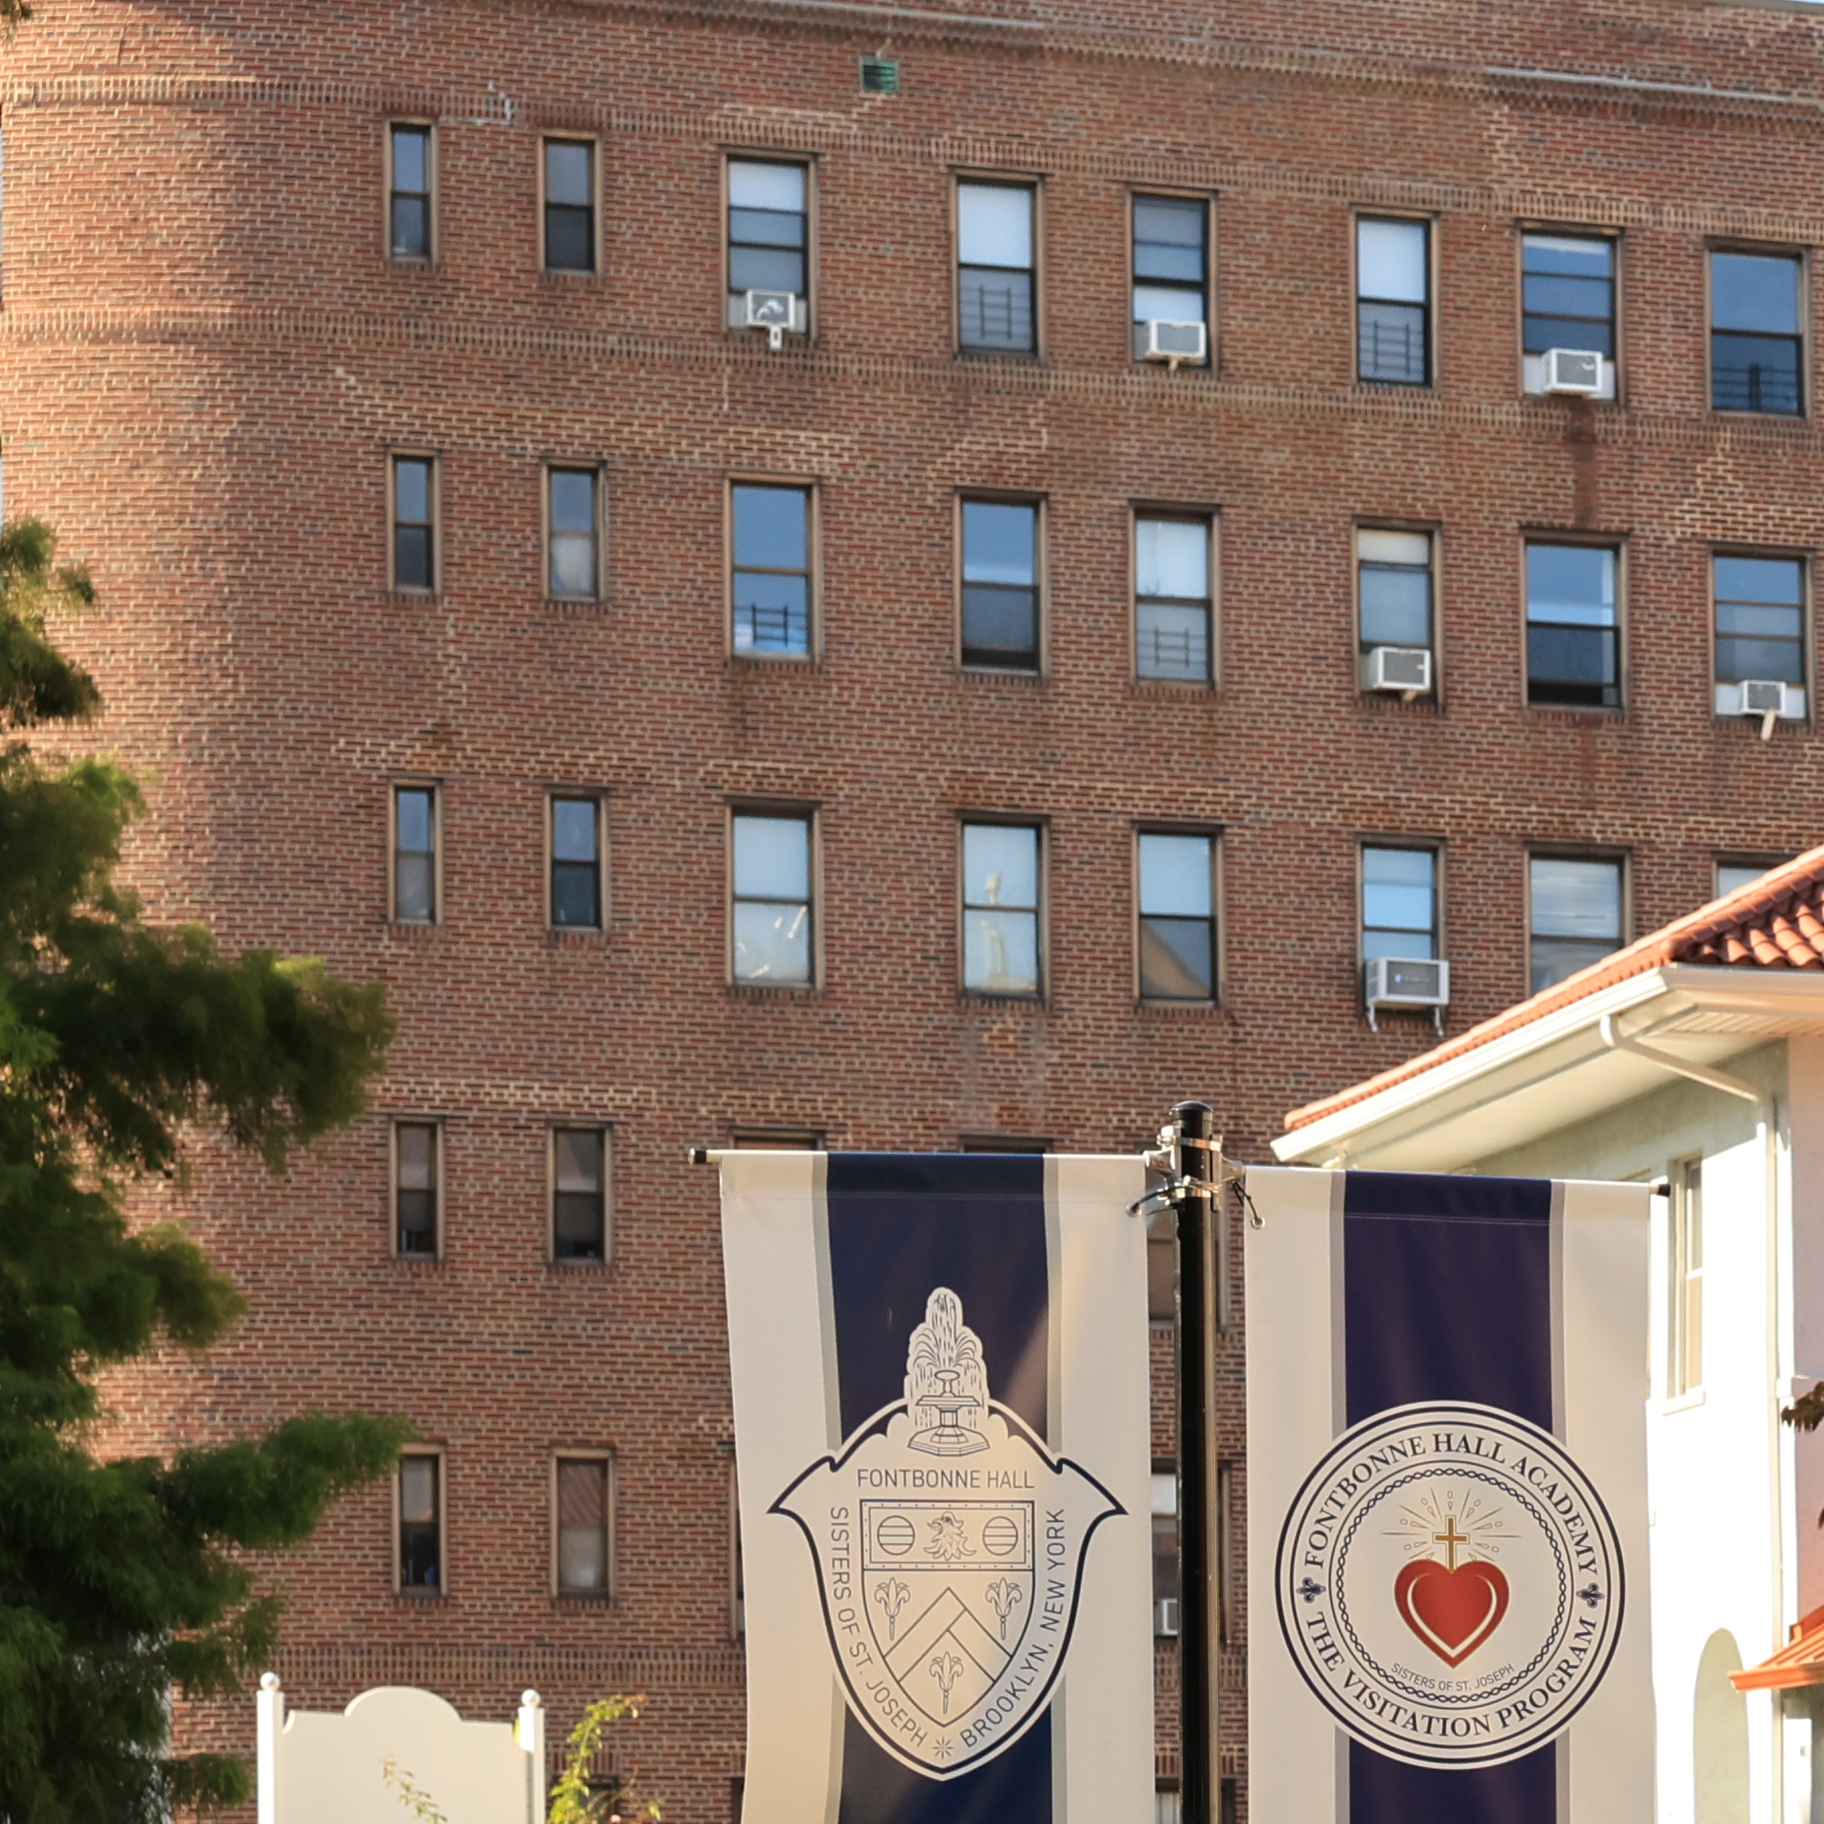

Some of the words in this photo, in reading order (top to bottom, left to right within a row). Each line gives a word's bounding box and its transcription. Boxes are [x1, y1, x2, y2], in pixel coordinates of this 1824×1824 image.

[858, 1469, 980, 1488] FONTBONNE
[987, 1470, 1035, 1489] HALL
[1305, 1436, 1426, 1569] FONTBONNE
[1433, 1433, 1506, 1463] HALL
[1511, 1456, 1598, 1576] ACADEMY
[831, 1506, 851, 1601] SISTERS
[1047, 1508, 1064, 1573] YORK
[838, 1608, 862, 1636] OF
[1040, 1579, 1065, 1632] NEW
[849, 1641, 873, 1676] ST.
[1306, 1611, 1345, 1672] THE
[1341, 1667, 1491, 1737] VISITATION
[1495, 1617, 1597, 1729] PROGRAM
[1390, 1662, 1435, 1690] SISTERS
[1438, 1681, 1452, 1691] OF
[1455, 1681, 1472, 1691] ST.
[1475, 1663, 1515, 1689] JOSEPH
[866, 1680, 928, 1747] JOSEPH
[960, 1642, 1054, 1748] BROOKLYN,
